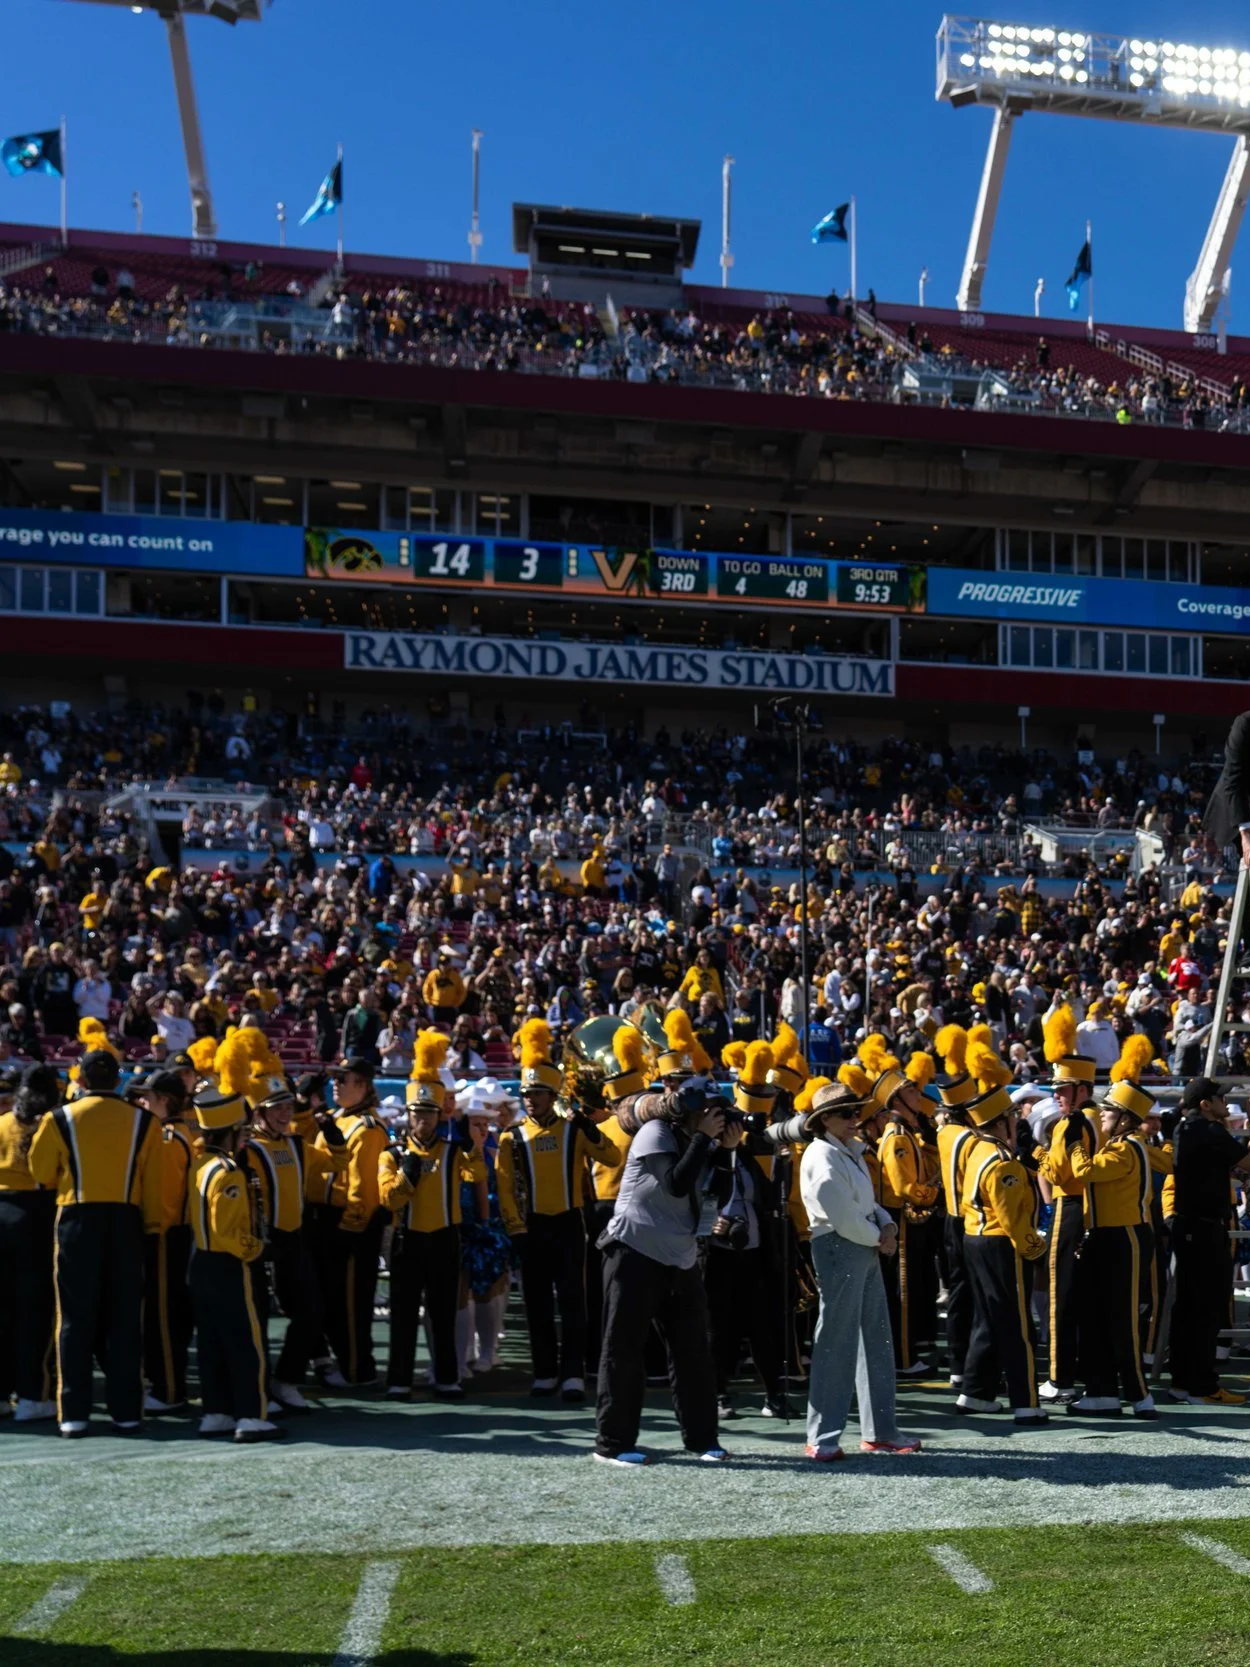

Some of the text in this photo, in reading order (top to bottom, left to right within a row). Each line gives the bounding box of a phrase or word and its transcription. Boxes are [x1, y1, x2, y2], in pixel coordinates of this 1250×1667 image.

[48, 531, 84, 547] you
[89, 533, 123, 547] can
[128, 535, 183, 551] count
[189, 537, 213, 552] on
[430, 543, 470, 576] 14
[520, 548, 539, 580] 3
[658, 556, 699, 571] DOWN
[724, 561, 761, 575] TO GO
[769, 563, 823, 578] BALL ON
[850, 568, 898, 582] 3RD QTR
[661, 573, 695, 592] 3RD
[735, 577, 747, 595] 4
[786, 580, 807, 598] 48
[855, 585, 890, 603] 9:53
[958, 582, 1082, 607] PROGRESSIVE
[348, 635, 895, 694] RAYMOND JAMES STADIUM
